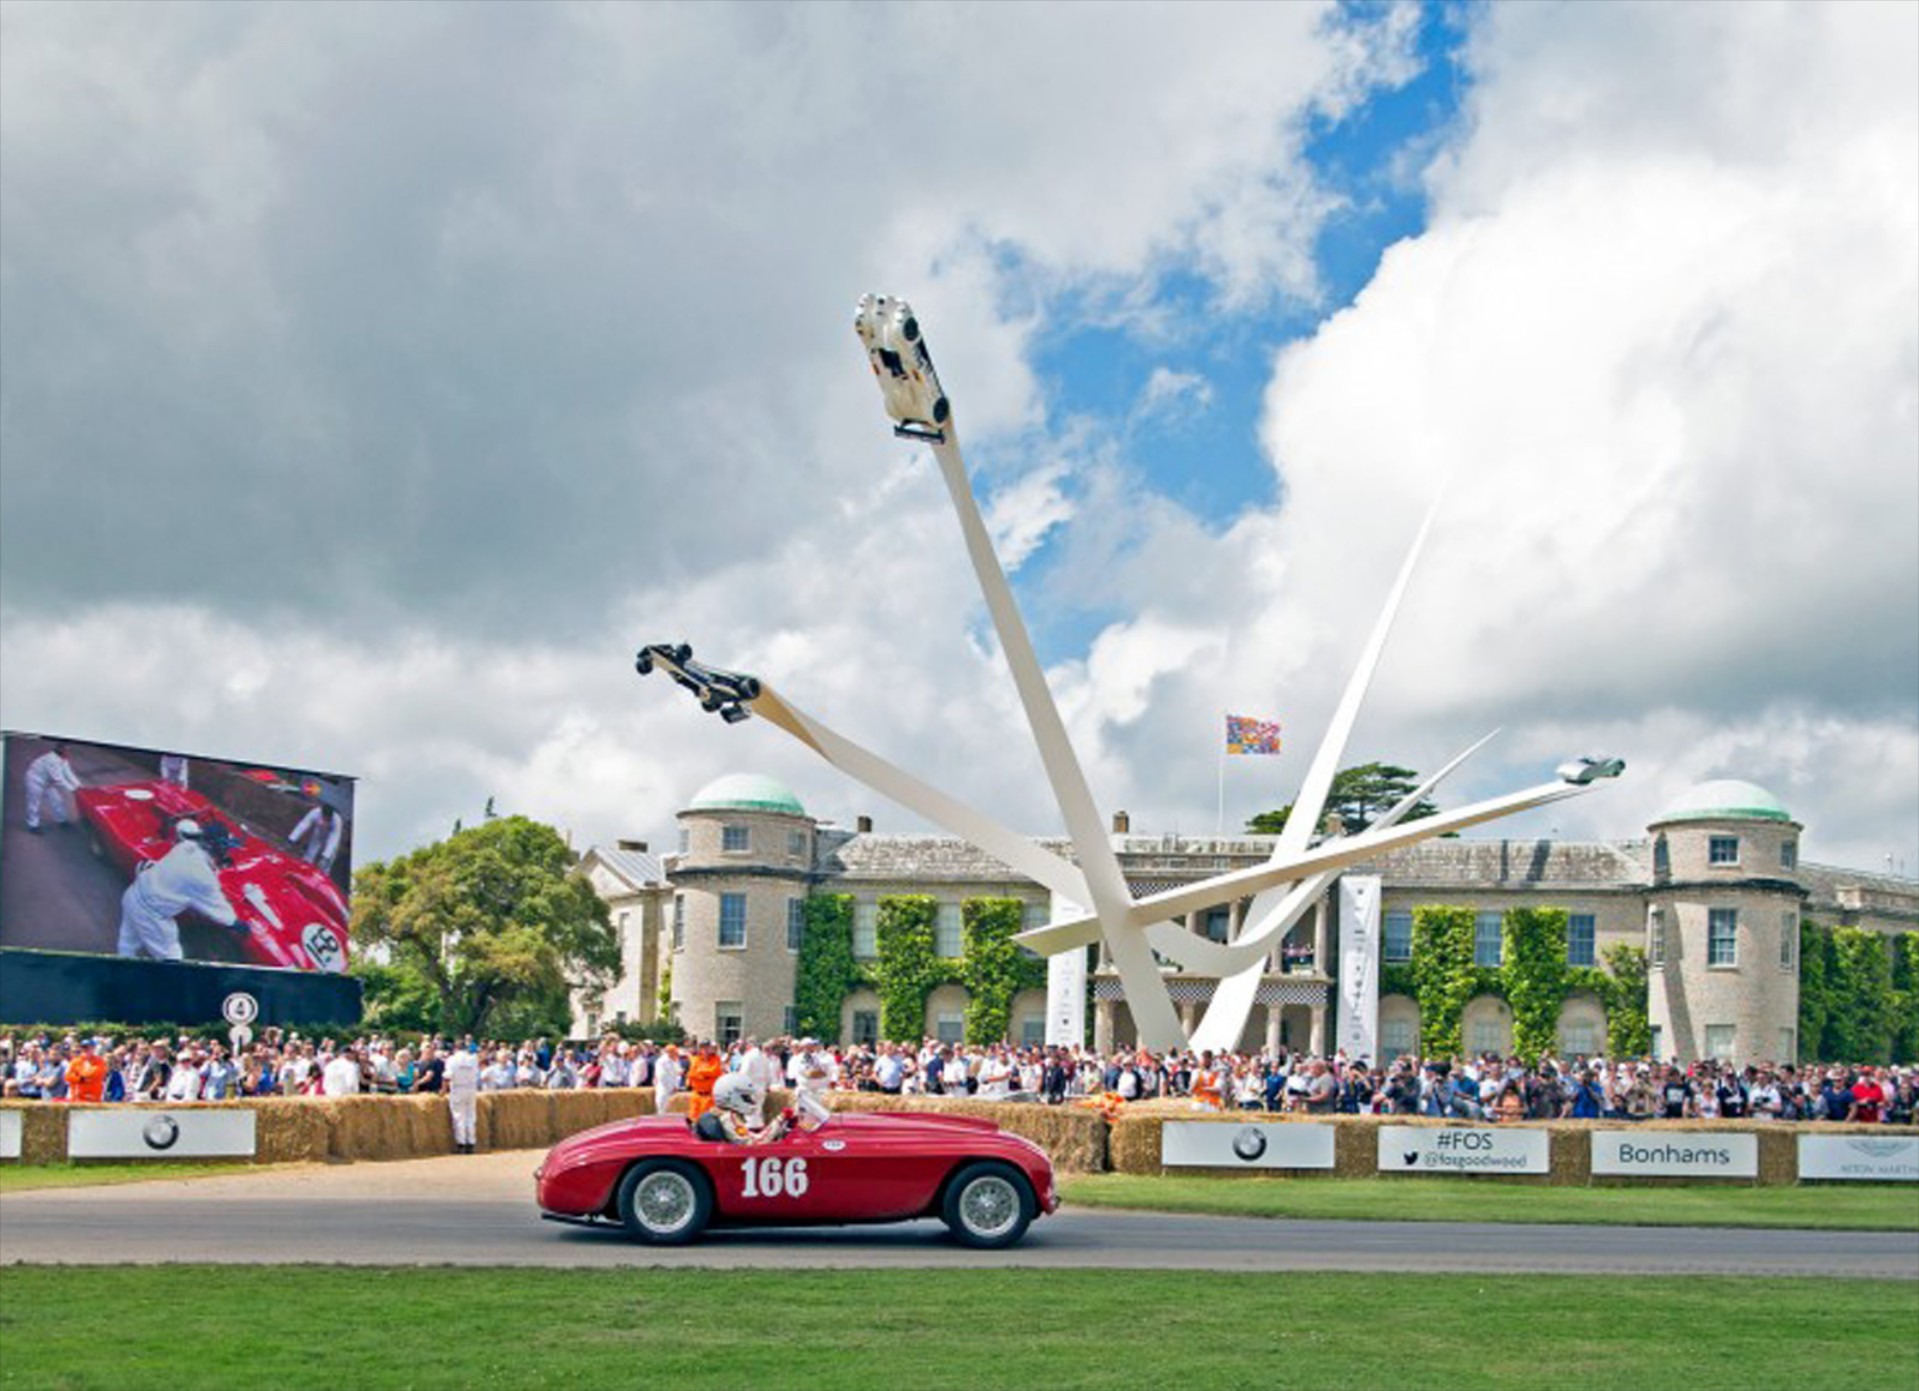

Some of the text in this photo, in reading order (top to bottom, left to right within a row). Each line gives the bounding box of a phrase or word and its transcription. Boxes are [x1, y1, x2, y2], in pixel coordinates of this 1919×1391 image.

[1437, 1132, 1493, 1150] #FOS
[1619, 1143, 1731, 1165] Bonhams
[741, 1157, 809, 1197] 166
